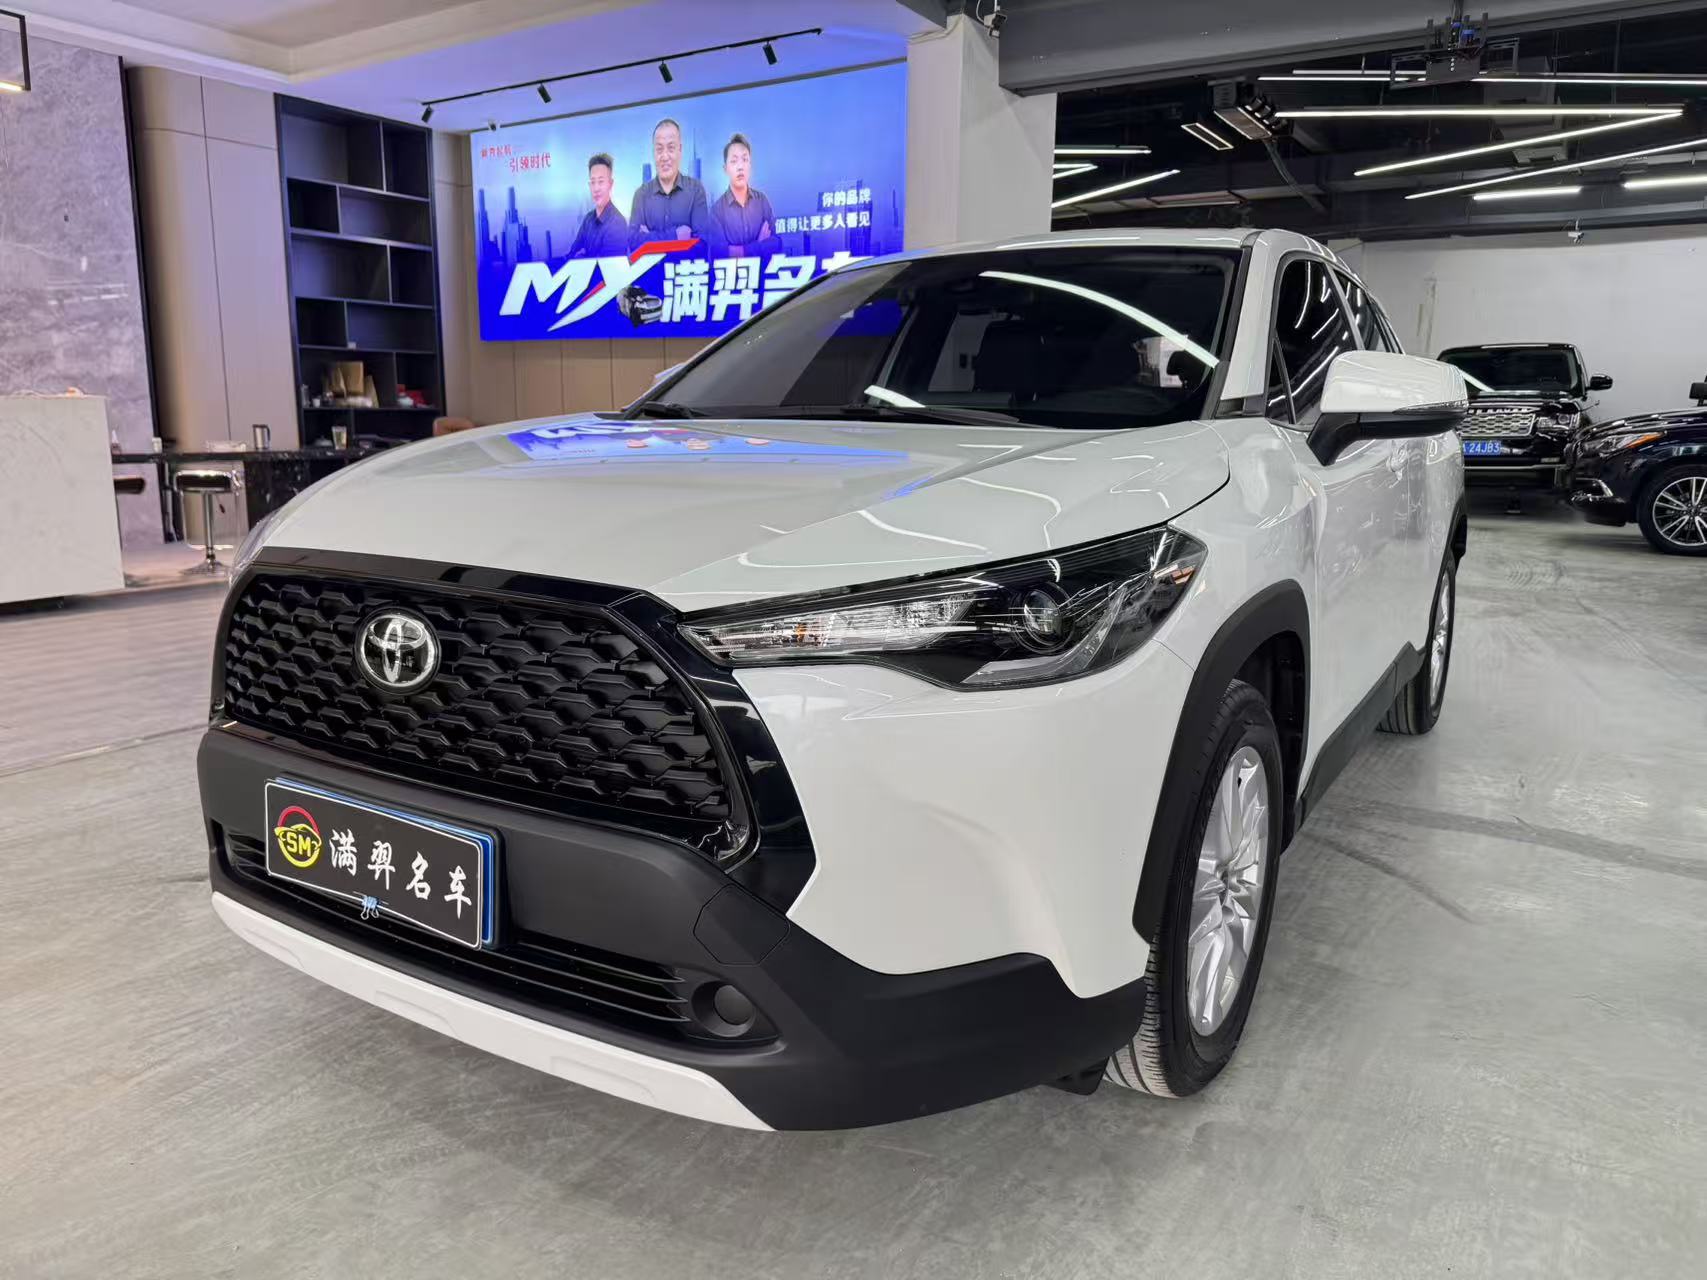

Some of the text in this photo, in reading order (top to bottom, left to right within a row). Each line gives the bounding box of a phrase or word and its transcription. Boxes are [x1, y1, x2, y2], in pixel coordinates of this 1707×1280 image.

[822, 187, 871, 208] 你的品牌
[775, 211, 870, 234] 值得让更多人看见
[329, 829, 472, 919] 满羿名车
